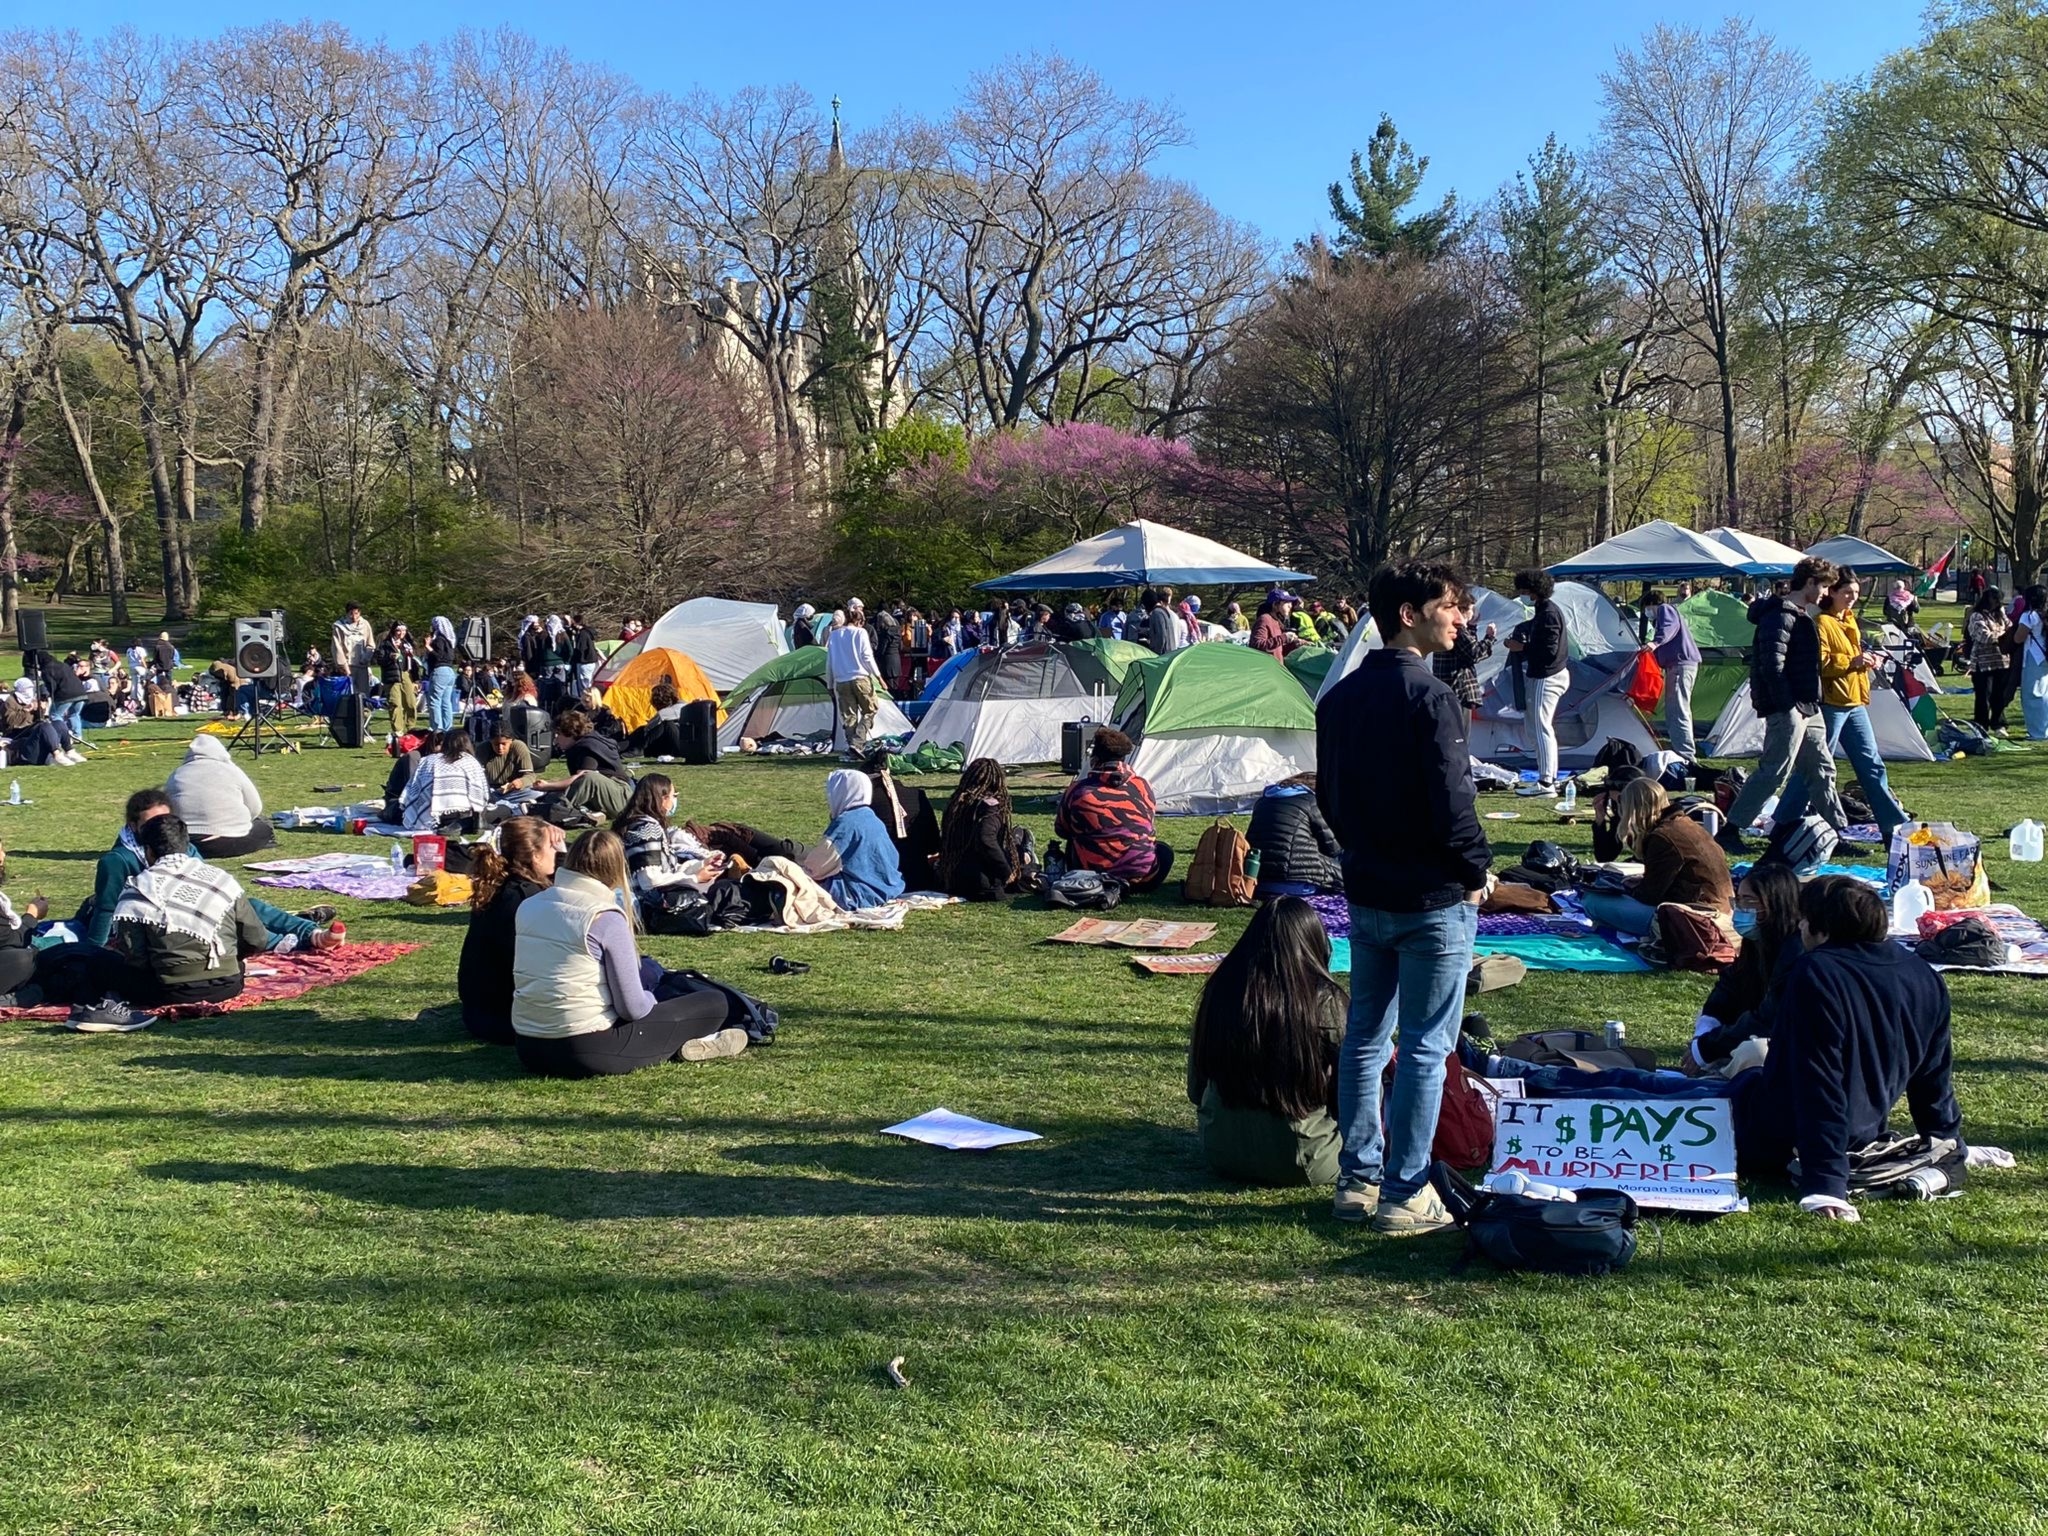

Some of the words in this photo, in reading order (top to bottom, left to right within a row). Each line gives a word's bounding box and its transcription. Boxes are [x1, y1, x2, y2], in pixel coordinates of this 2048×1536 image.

[1915, 851, 1957, 870] SUNSINE
[1501, 1102, 1553, 1125] IT
[1590, 1104, 1717, 1147] PAYS
[1532, 1145, 1563, 1157] TO
[1575, 1147, 1604, 1159] BE
[1612, 1148, 1633, 1160] A
[1617, 1184, 1667, 1193] Morgan
[1670, 1186, 1720, 1195] Stanley
